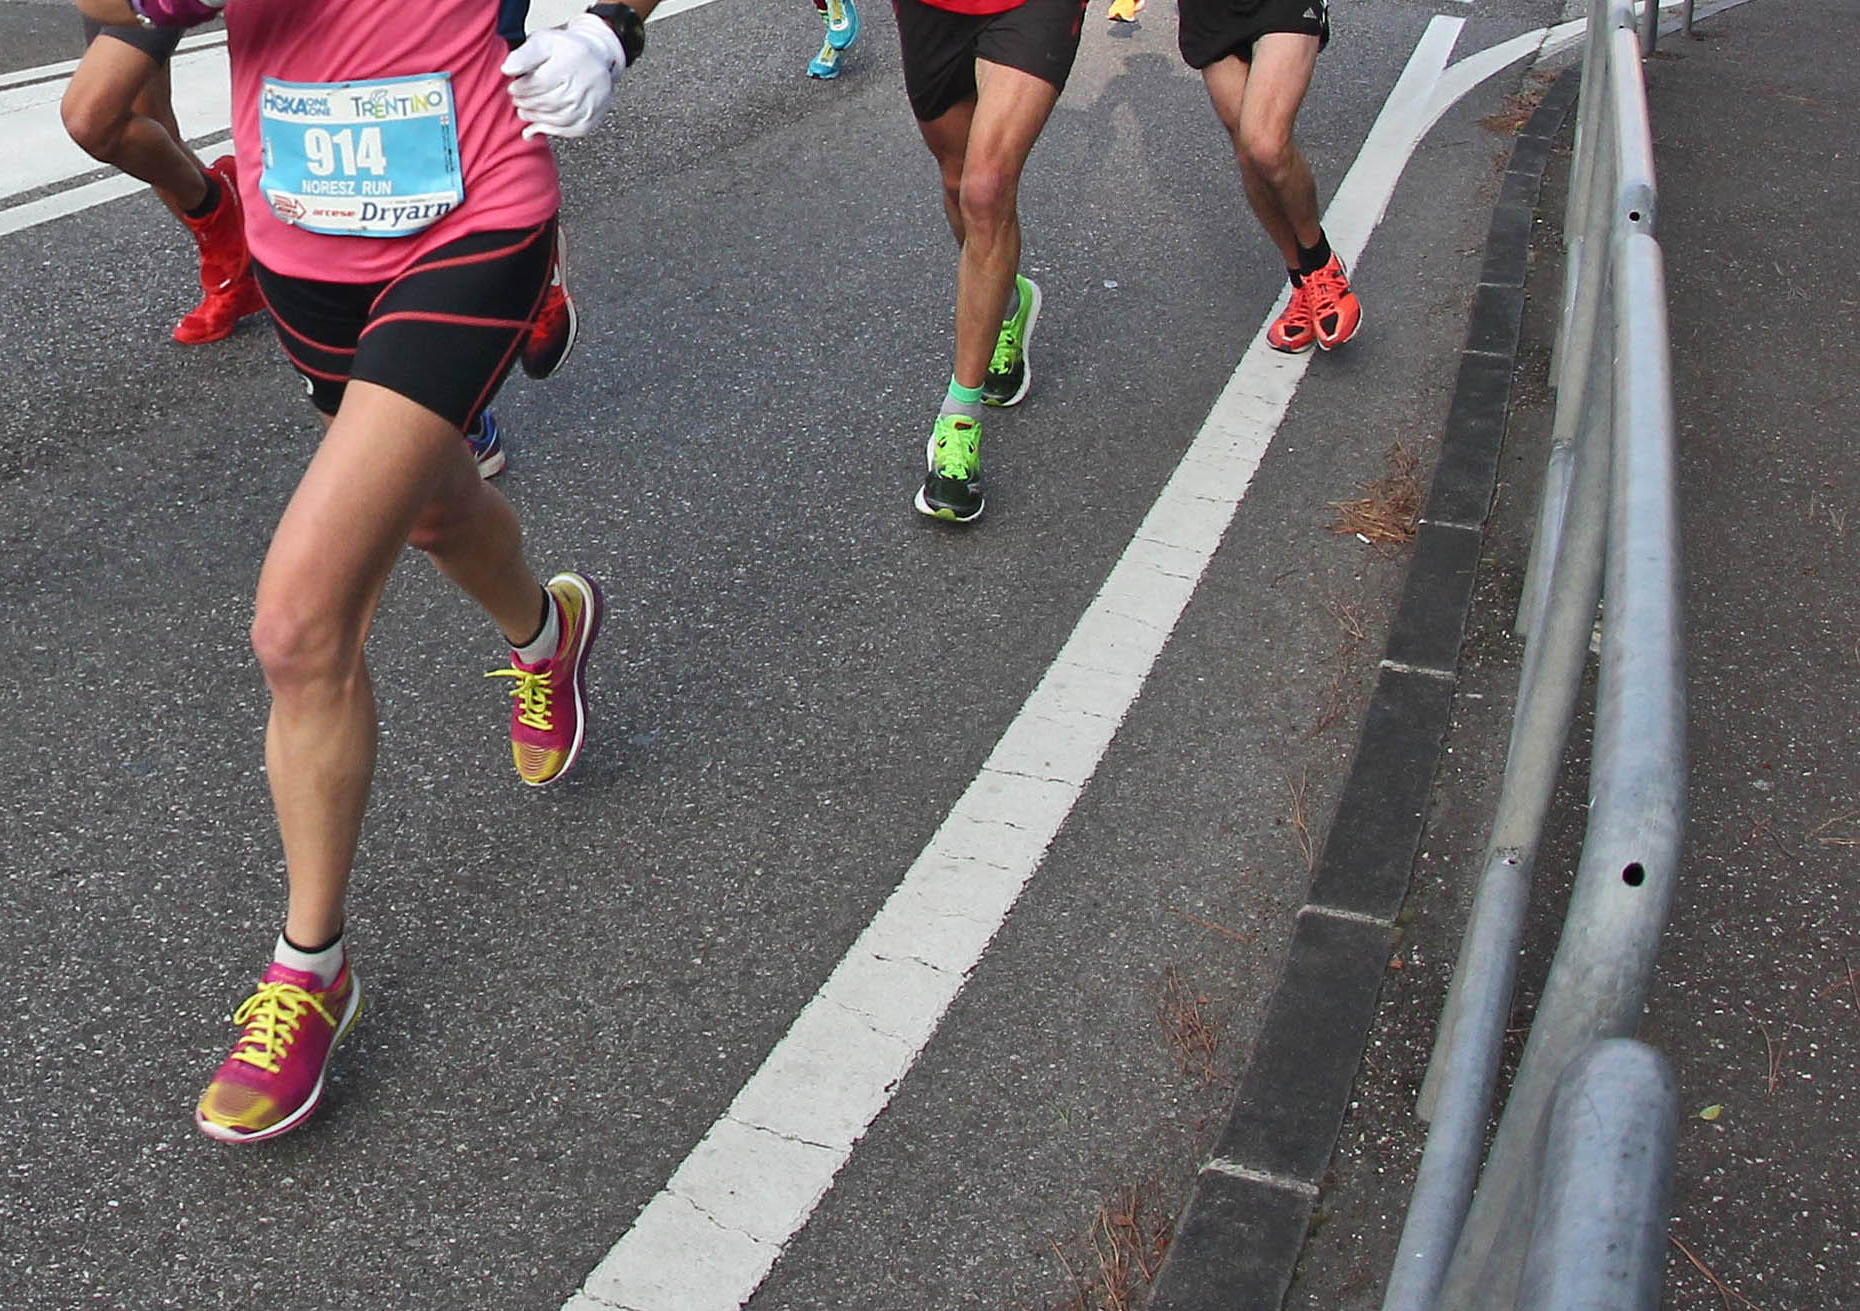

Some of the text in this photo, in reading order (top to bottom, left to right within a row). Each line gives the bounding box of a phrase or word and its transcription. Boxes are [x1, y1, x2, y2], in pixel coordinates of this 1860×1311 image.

[263, 89, 442, 119] HOKA ONE TRENTINO
[303, 126, 387, 177] 914
[301, 180, 393, 196] NORESZ RUN
[359, 200, 452, 228] Dryarn
